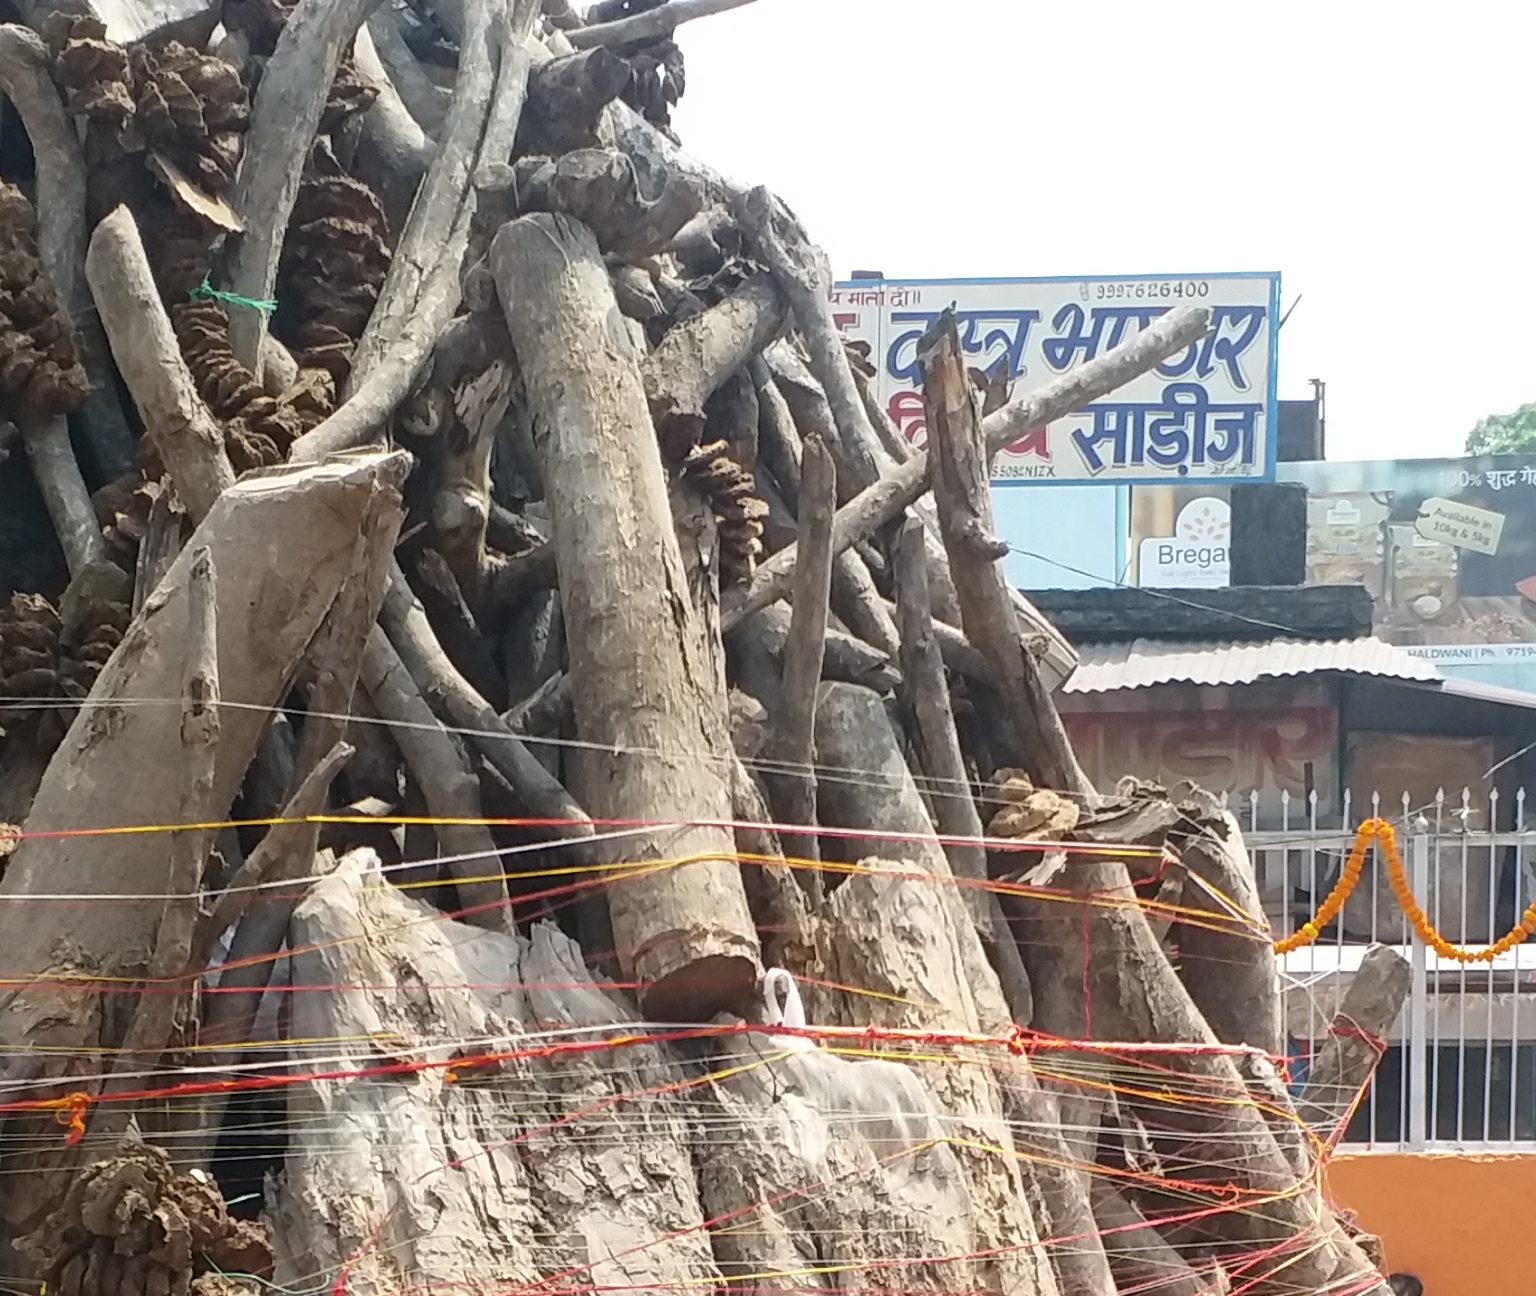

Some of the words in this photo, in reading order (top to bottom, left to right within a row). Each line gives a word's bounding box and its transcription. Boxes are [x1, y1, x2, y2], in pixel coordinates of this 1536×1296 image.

[1096, 282, 1209, 299] 9997626400
[1433, 507, 1480, 529] Available
[1481, 520, 1492, 530] in
[1433, 521, 1458, 538] 10kg
[1471, 532, 1491, 546] 5kg
[1408, 648, 1472, 659] HALDWANI
